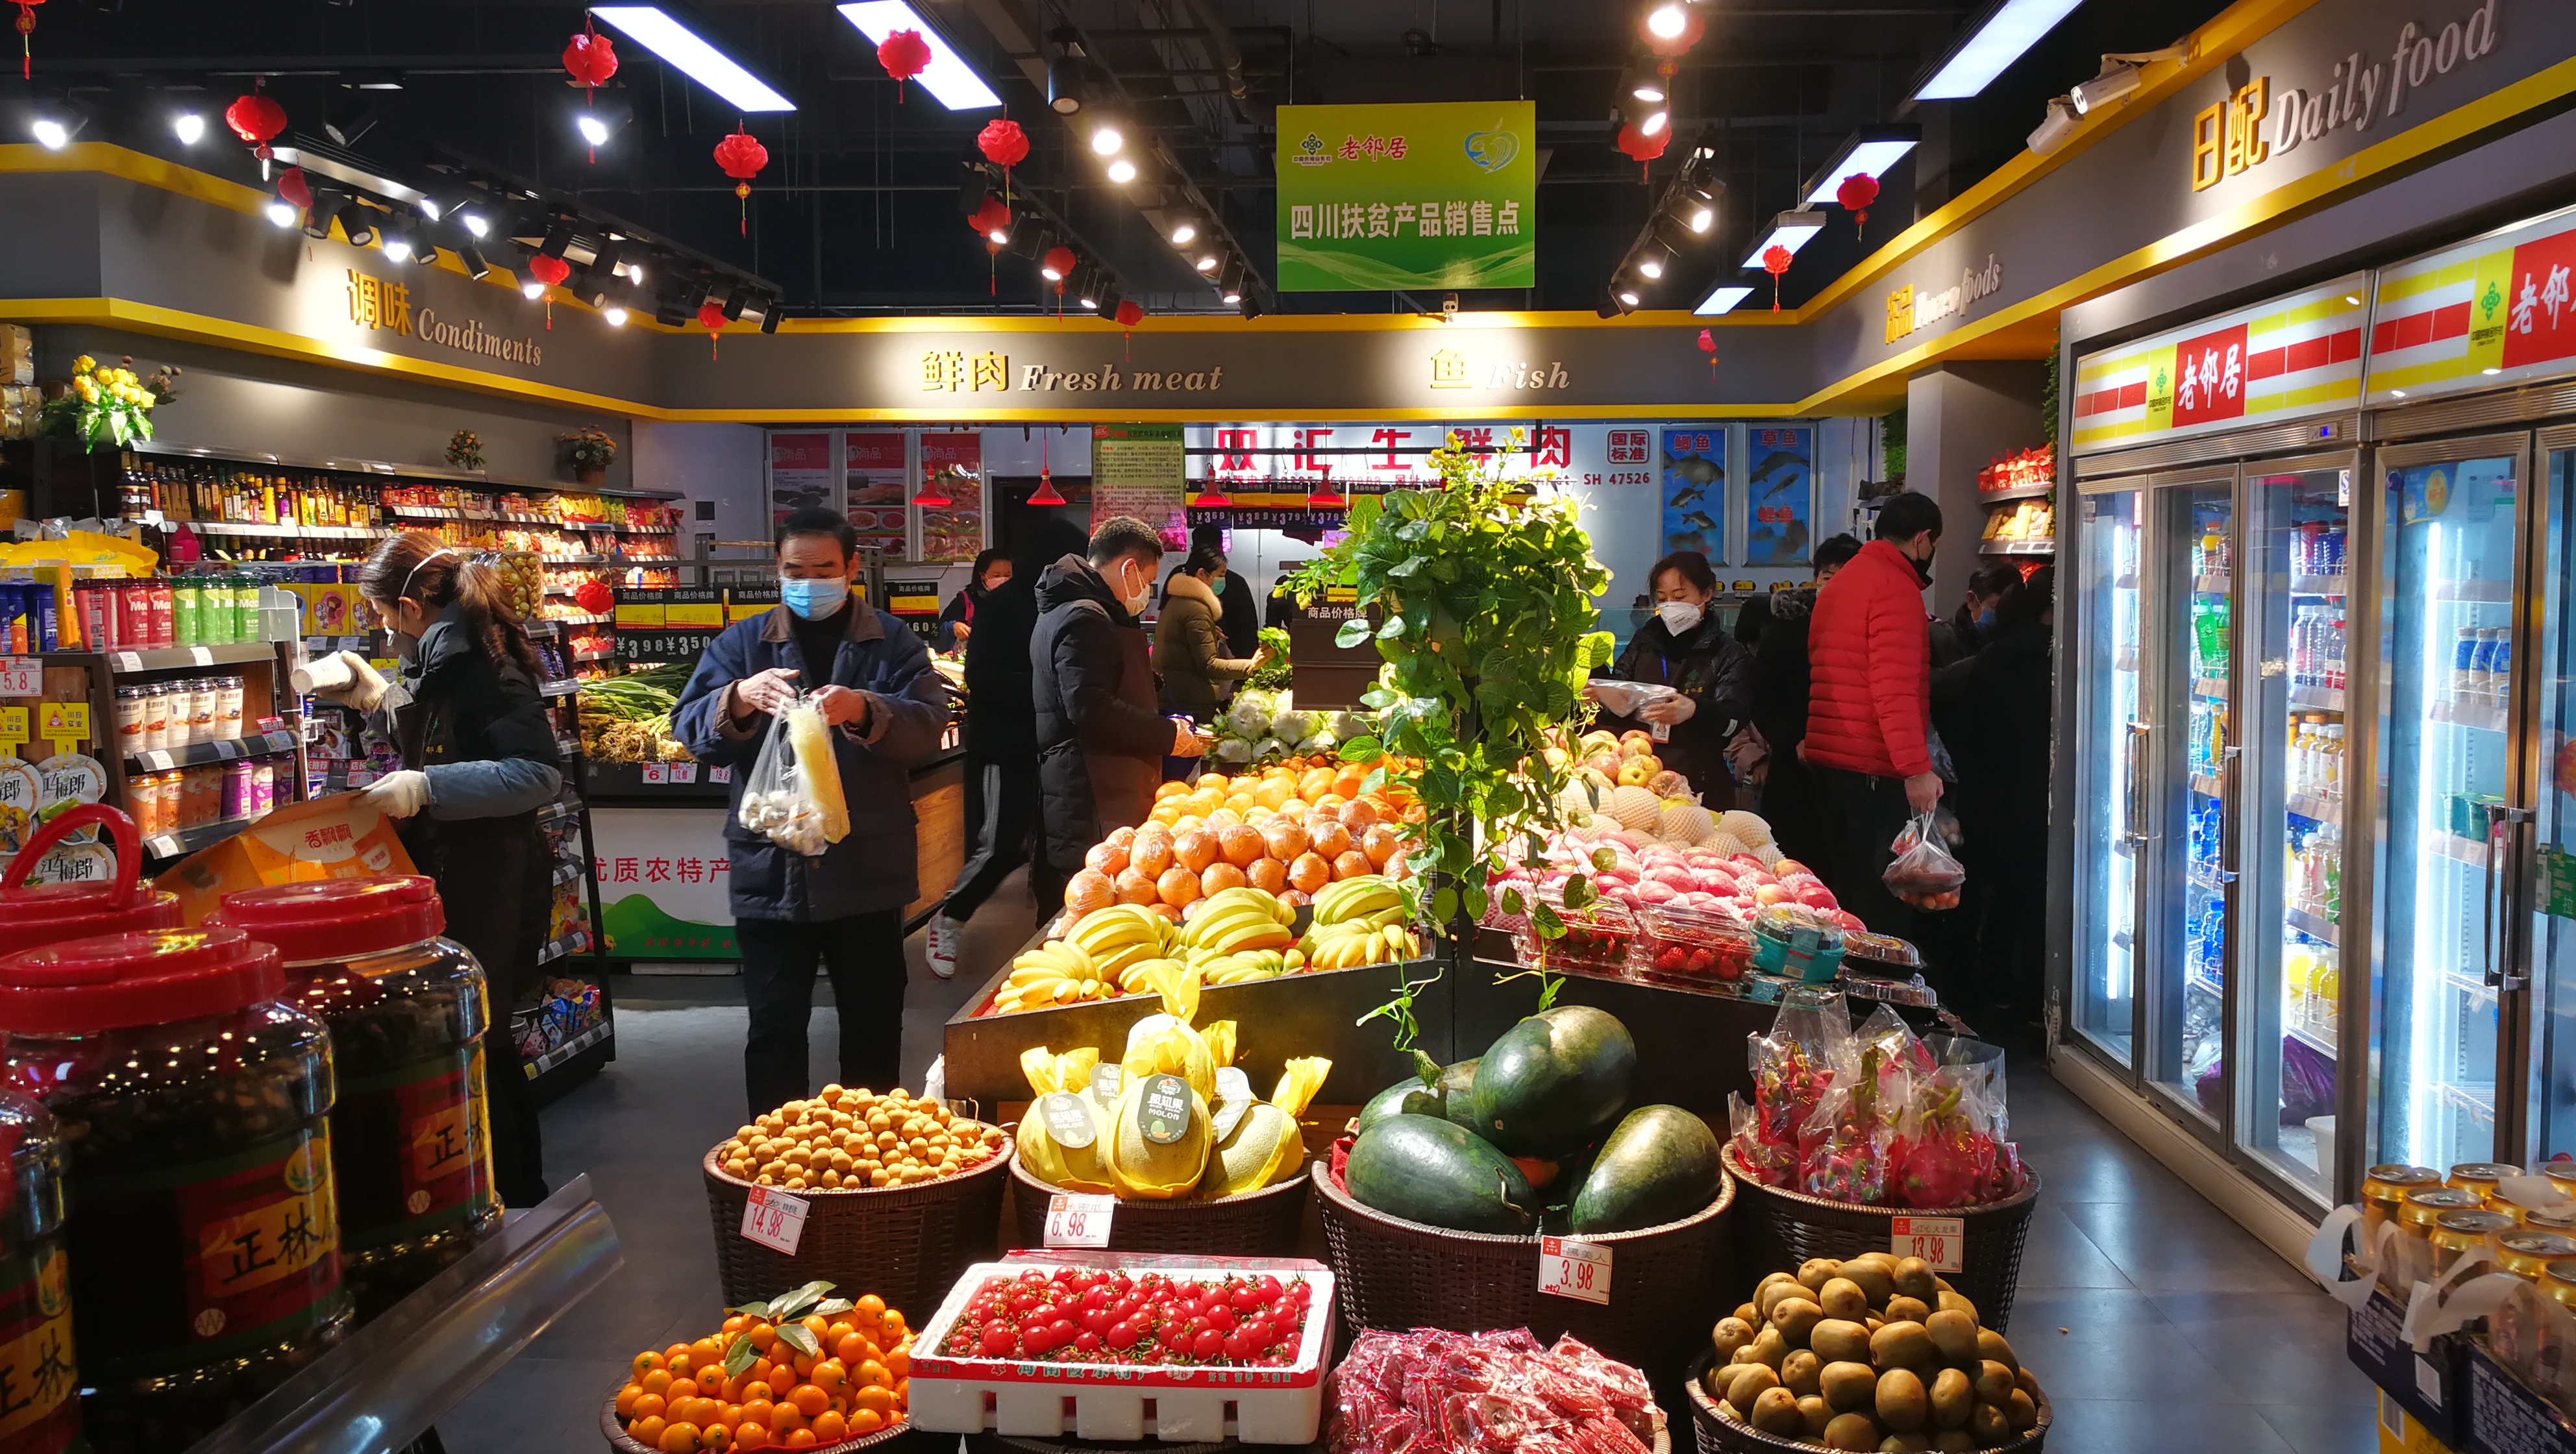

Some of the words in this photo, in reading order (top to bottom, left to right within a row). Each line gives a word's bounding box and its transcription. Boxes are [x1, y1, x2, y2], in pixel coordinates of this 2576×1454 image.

[2270, 51, 2383, 158] Daily
[2384, 0, 2498, 116] food
[1339, 135, 1407, 161] 老邻居
[2192, 77, 2270, 193] 日配
[1291, 199, 1520, 240] 四川扶贫产品销售点
[1959, 253, 2000, 317] foods
[347, 268, 413, 336] 调味
[2510, 264, 2576, 334] 老邻
[418, 308, 541, 366] Condiments
[921, 350, 1010, 391] 鲜肉
[1018, 364, 1122, 391] Fresh
[1132, 364, 1223, 391] meat
[1430, 348, 1471, 389] 鱼
[1486, 361, 1570, 390] Fish
[2178, 343, 2241, 410] 老邻居
[1611, 433, 1646, 447] 国际
[1674, 434, 1711, 452] 鲫鱼
[1761, 430, 1798, 447] 草鱼
[1611, 447, 1647, 462] 标准
[1583, 473, 1602, 486] SH
[1609, 472, 1651, 485] 47526
[622, 591, 663, 600] 商品价格牌
[674, 591, 715, 599] 商品价格牌
[737, 591, 779, 599] 商品价格牌
[1307, 606, 1368, 620] 商品价格牌
[4, 672, 28, 691] 5.8
[648, 770, 660, 780] 6
[304, 824, 354, 849] 香飘飘
[1148, 1108, 1180, 1121] MOLON
[750, 1205, 784, 1237] 14.98
[1052, 1212, 1087, 1237] 6.98
[1912, 1237, 1944, 1264] 13.98
[1560, 1259, 1594, 1290] 3.98
